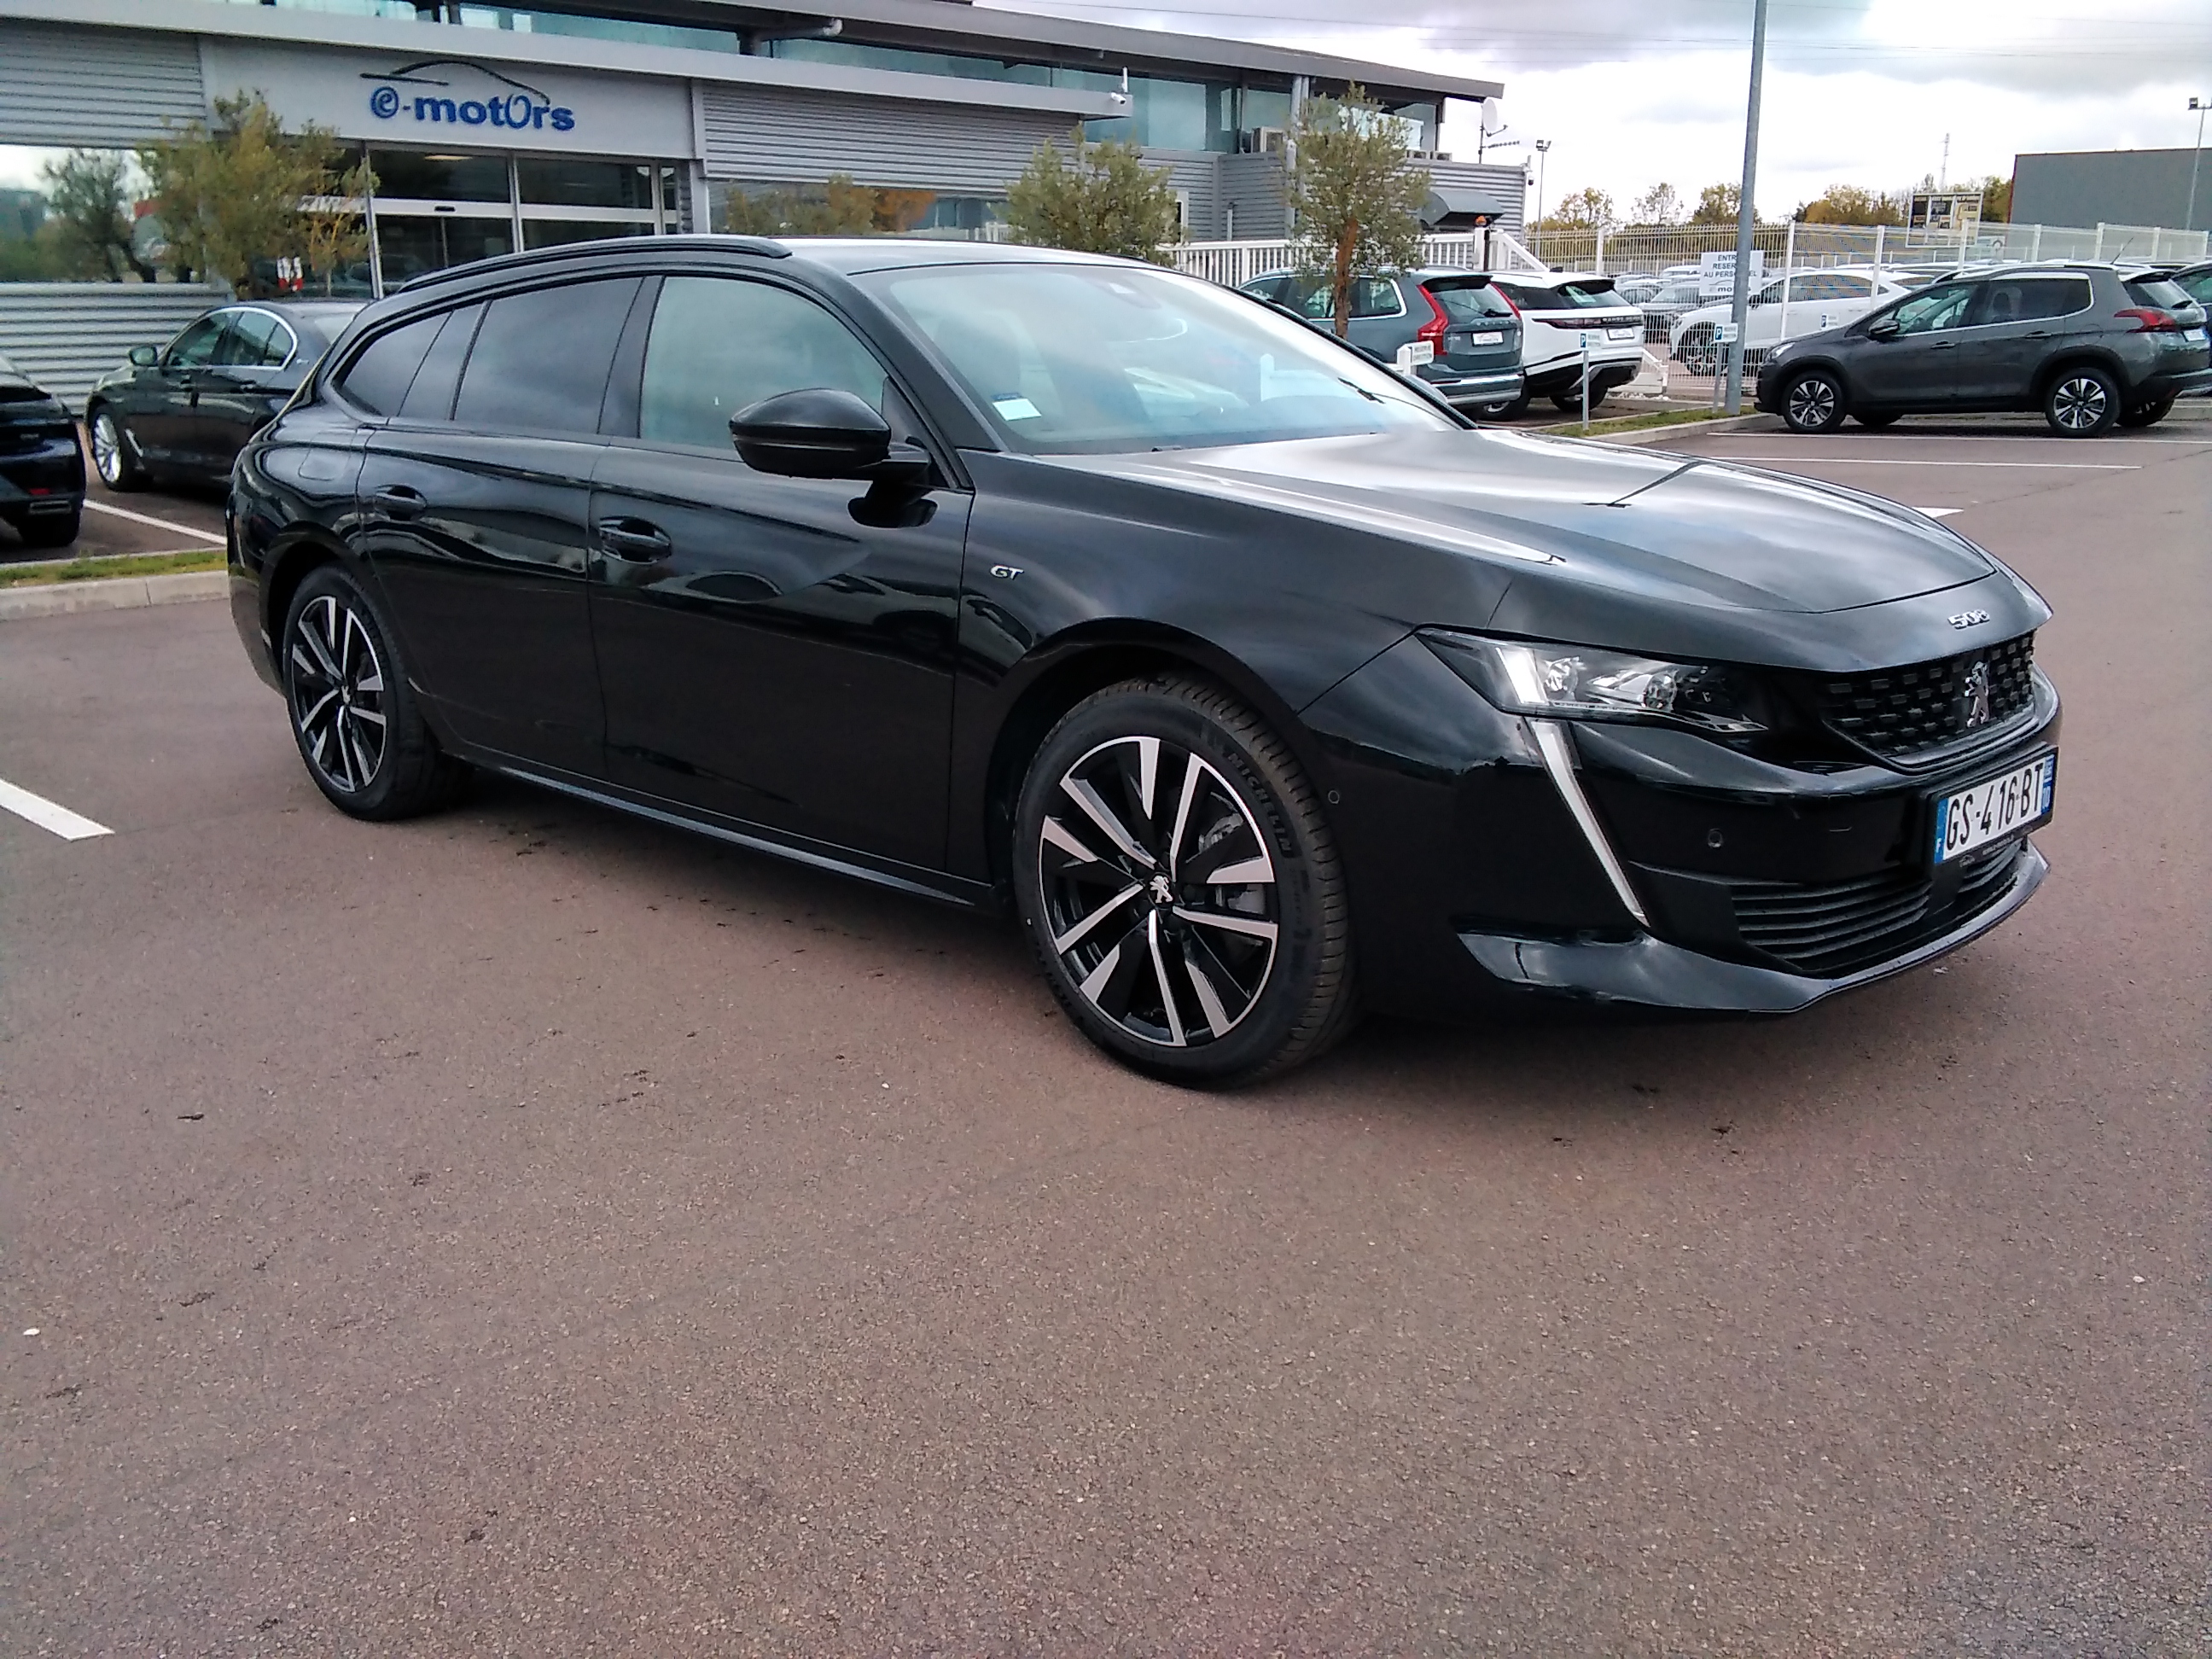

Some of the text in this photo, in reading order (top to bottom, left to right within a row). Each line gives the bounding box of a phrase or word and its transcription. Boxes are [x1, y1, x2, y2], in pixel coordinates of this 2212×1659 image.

[990, 564, 1024, 580] GT
[1947, 609, 1989, 630] 508
[1227, 752, 1293, 853] MICHELIN
[1946, 763, 2044, 851] GS-416-BT
